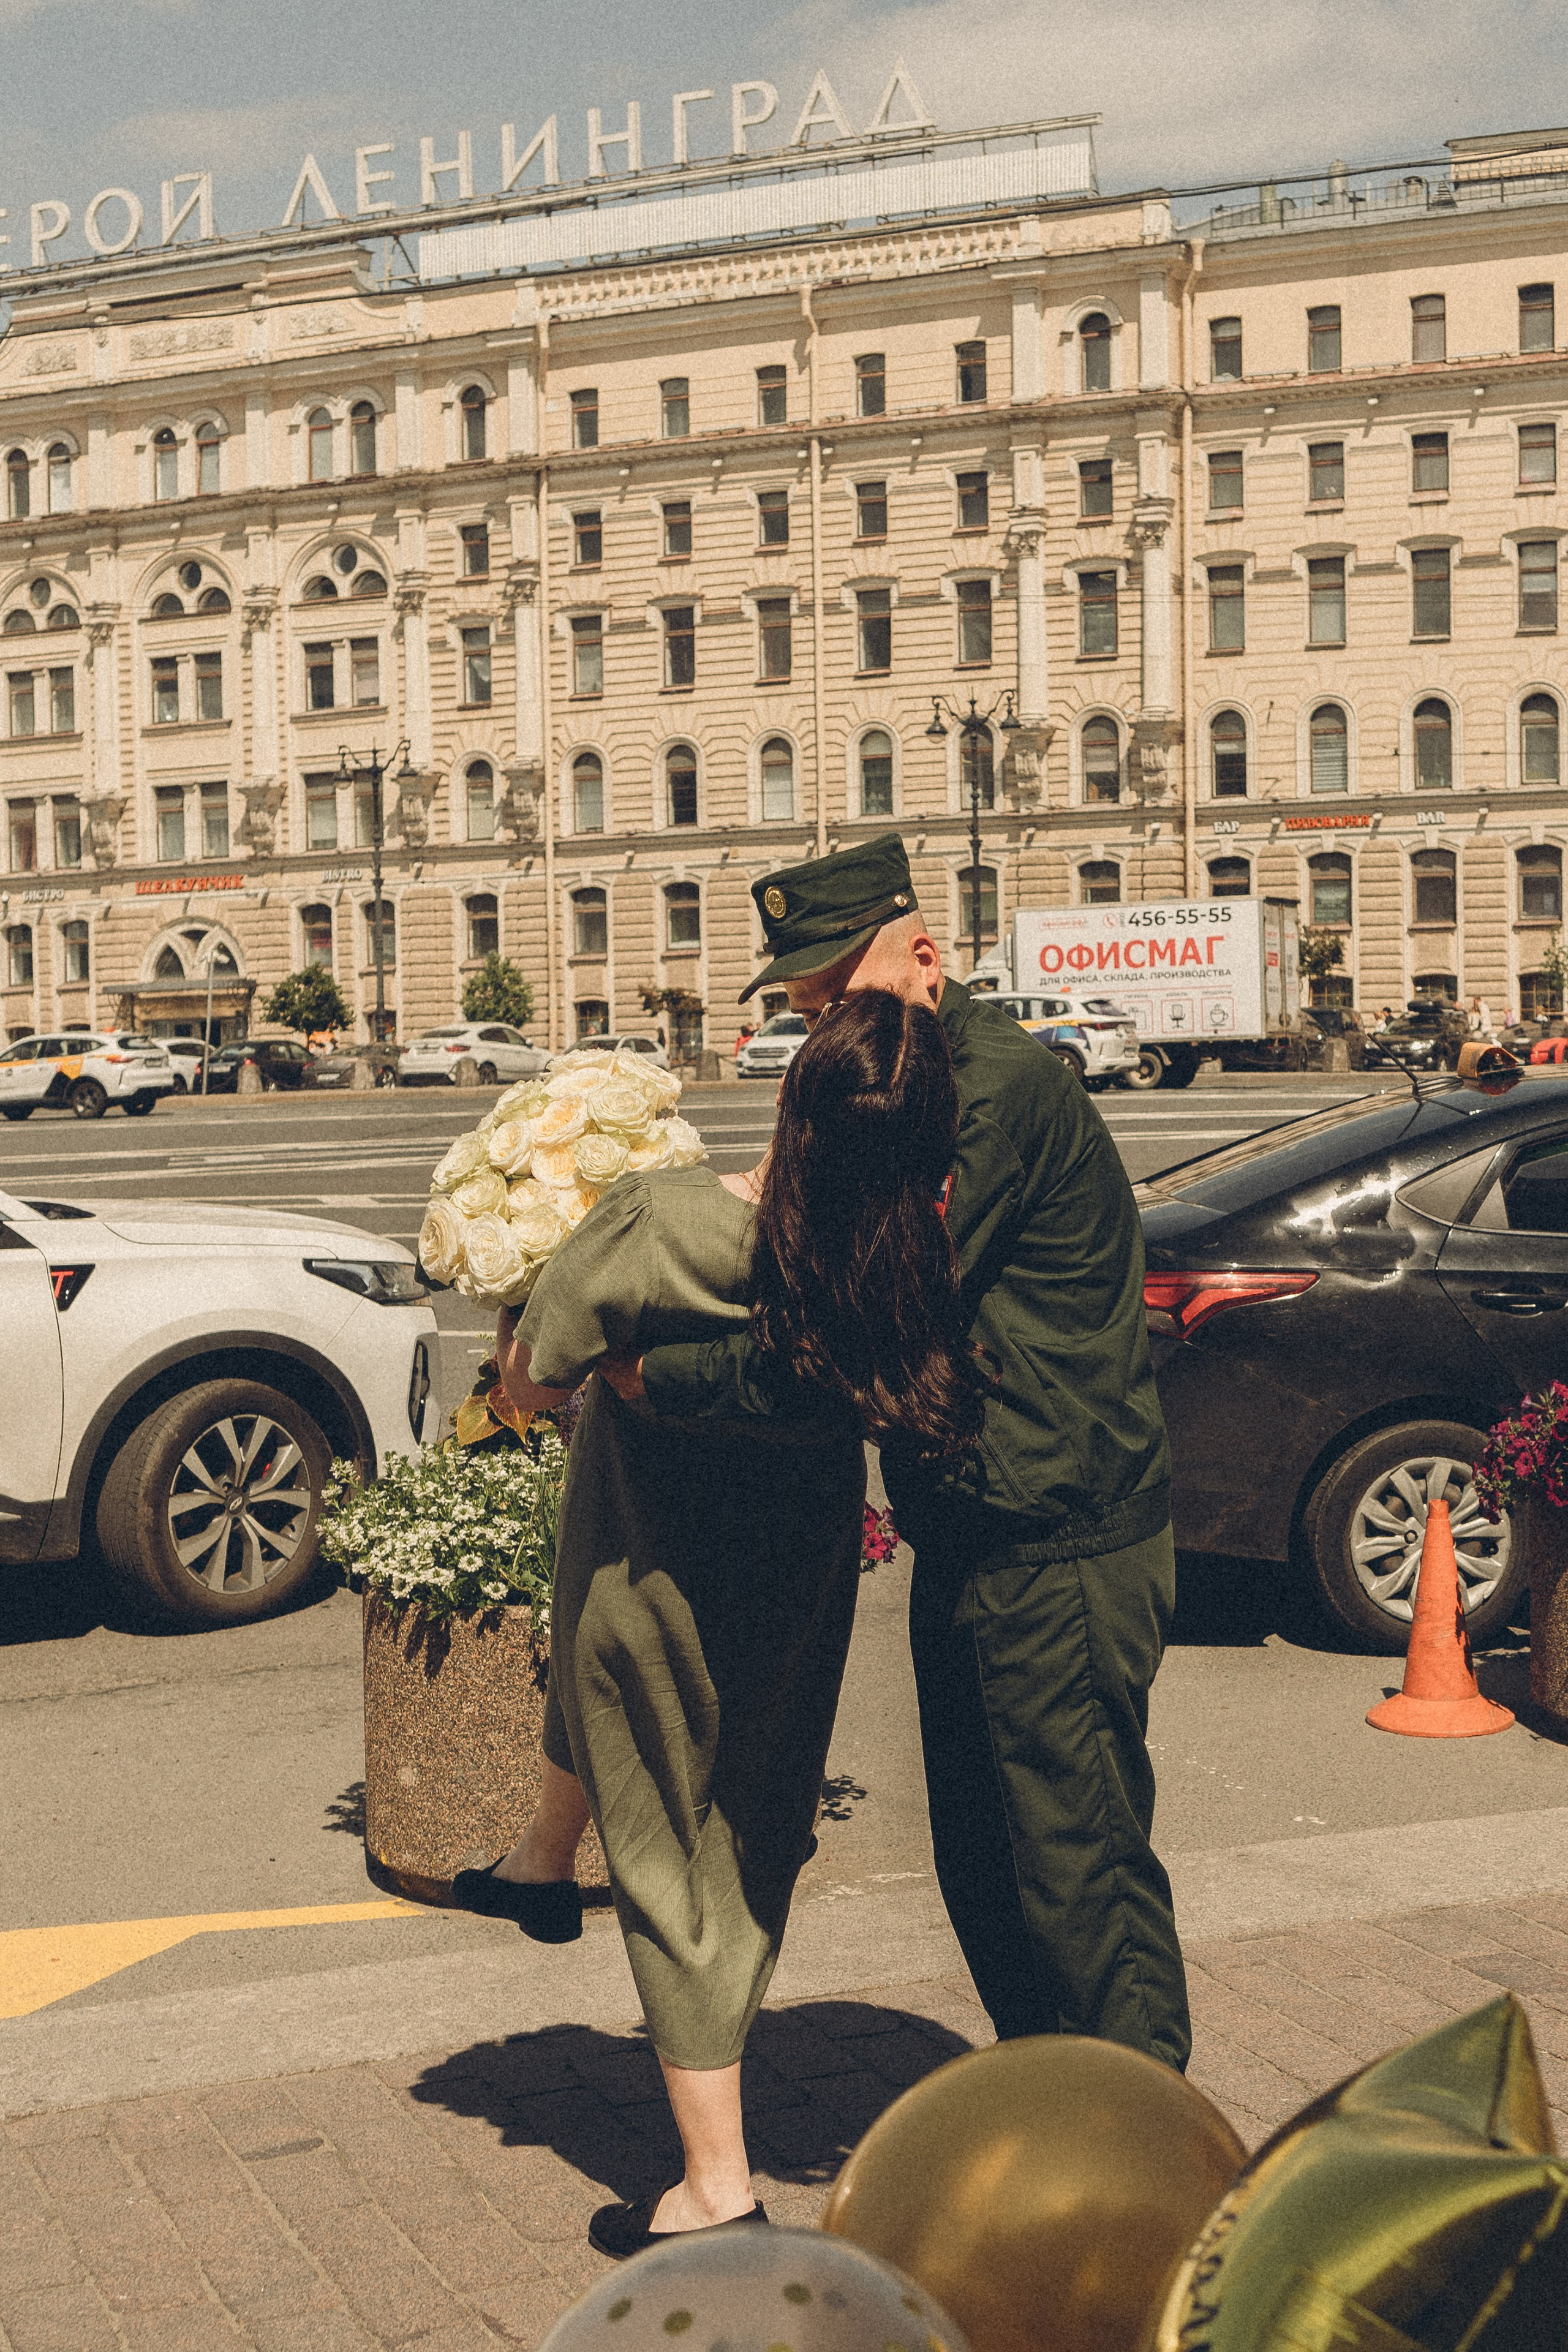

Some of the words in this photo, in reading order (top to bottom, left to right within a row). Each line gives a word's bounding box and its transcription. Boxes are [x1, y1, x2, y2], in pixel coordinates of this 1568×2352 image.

[282, 56, 937, 227] ЛЕНИНГРАД
[1286, 815, 1369, 829] ПИВОВАРНЯ
[1417, 811, 1445, 824] BAR
[1213, 821, 1240, 834] БАР
[1128, 907, 1232, 927] 456-55-55
[1039, 936, 1224, 973] ОФИСМАГ
[1039, 976, 1060, 986] ДЛЯ
[1150, 969, 1232, 979] ПРОИЗВОДСТВА
